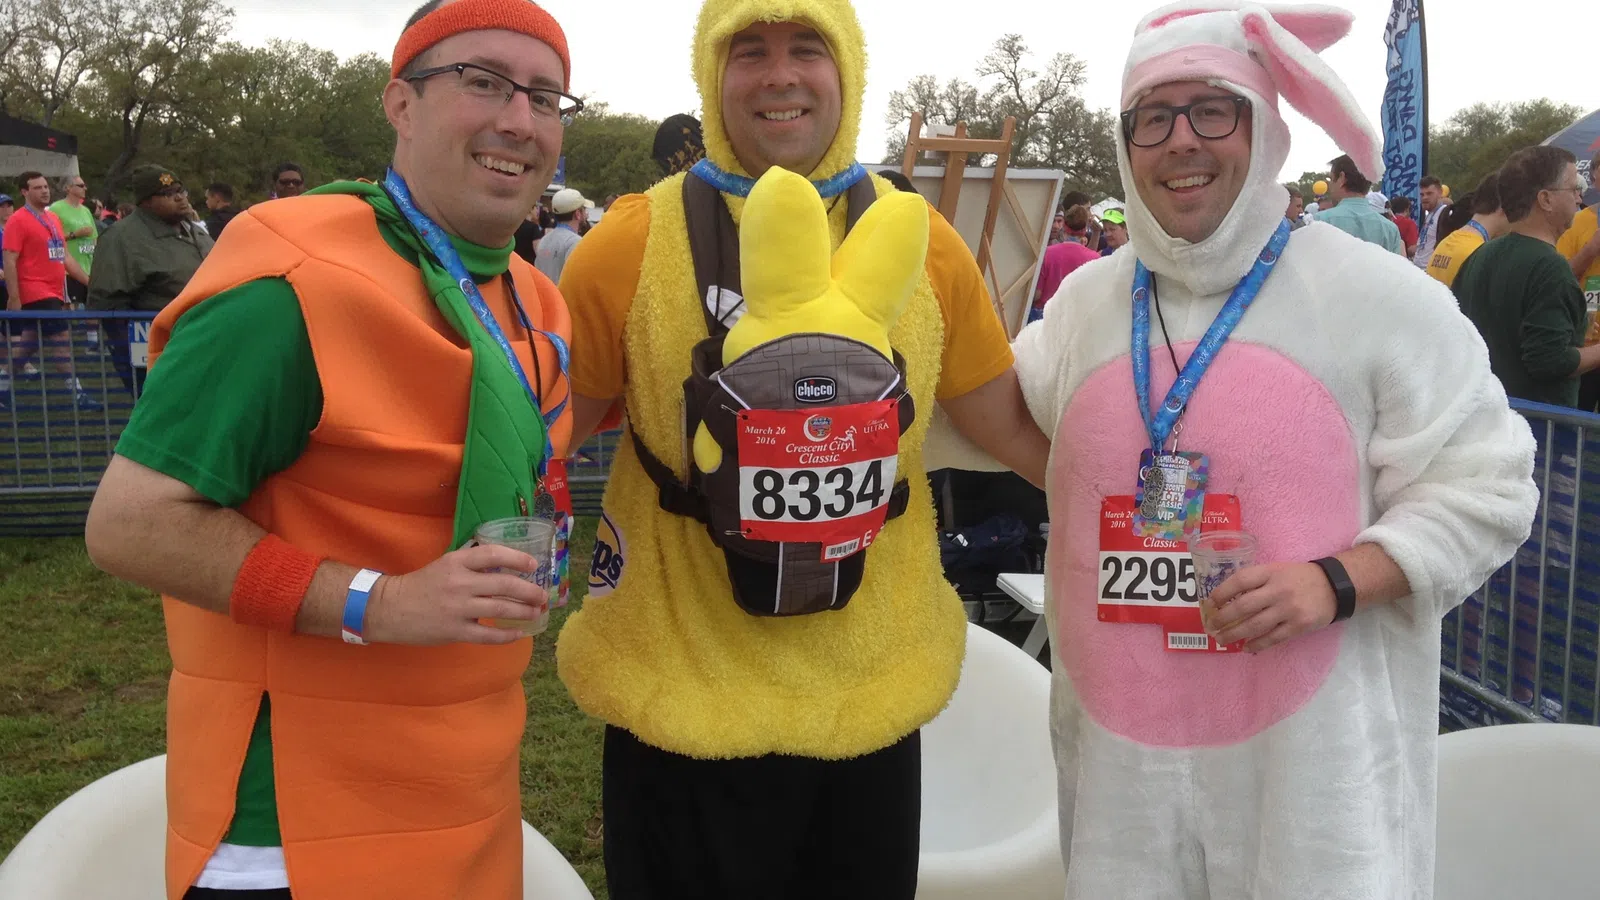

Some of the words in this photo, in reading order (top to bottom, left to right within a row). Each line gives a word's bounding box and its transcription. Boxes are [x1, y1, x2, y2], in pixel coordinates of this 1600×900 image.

[797, 380, 833, 397] chicco
[745, 425, 773, 435] March
[775, 426, 786, 435] 26
[863, 422, 890, 434] ULTRA
[755, 436, 776, 445] 2016
[785, 443, 827, 453] Crescent
[828, 440, 851, 452] City
[799, 452, 840, 464] Classic
[752, 459, 884, 521] 8334
[1105, 511, 1125, 519] March
[1157, 511, 1175, 521] VIP
[1110, 520, 1126, 528] 2016
[1101, 556, 1200, 603] 2295
